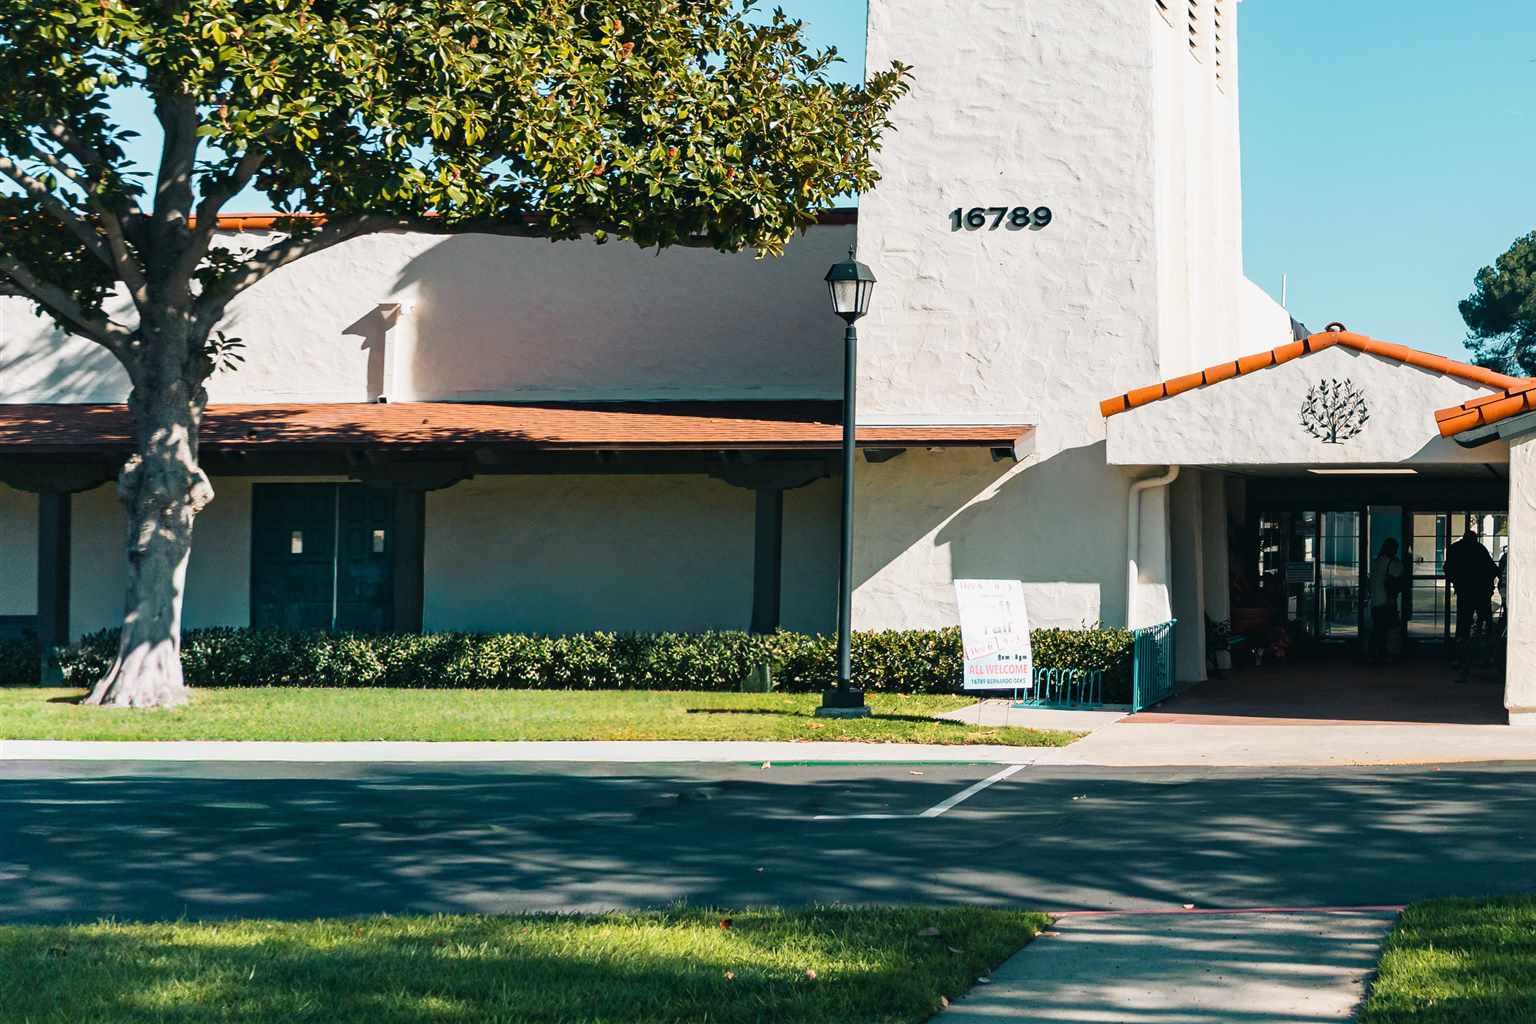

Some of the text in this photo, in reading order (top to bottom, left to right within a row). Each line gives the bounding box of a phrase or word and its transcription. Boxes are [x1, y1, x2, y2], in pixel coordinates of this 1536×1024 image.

[949, 207, 1052, 231] 16789
[969, 663, 1029, 675] ALL WELCOME
